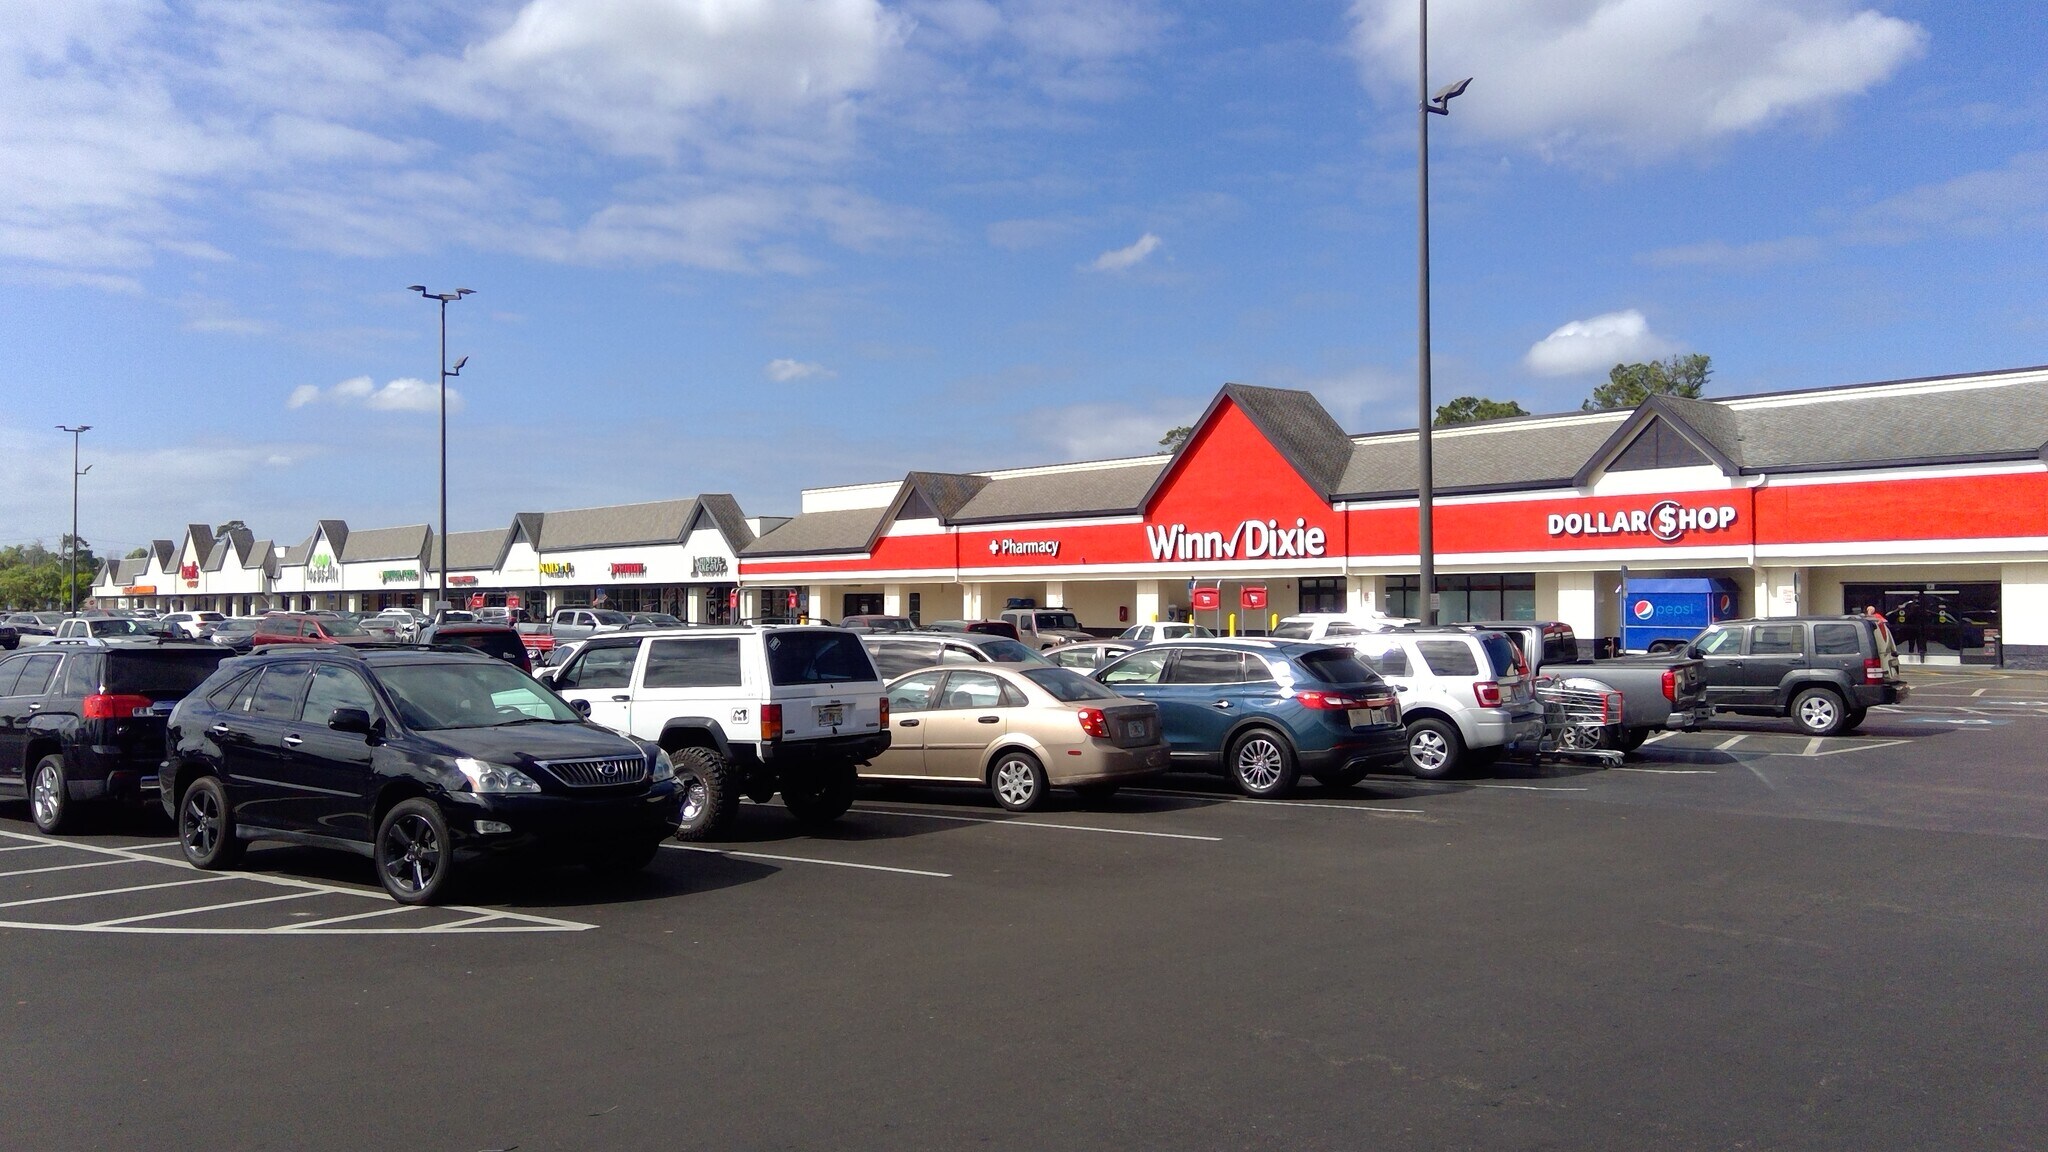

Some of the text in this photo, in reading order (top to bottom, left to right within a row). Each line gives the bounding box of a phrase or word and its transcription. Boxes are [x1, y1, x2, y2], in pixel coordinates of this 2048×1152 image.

[1548, 510, 1649, 535] DOLLAR
[1001, 539, 1060, 557] Pharmacy
[1146, 517, 1326, 560] Winn Dixie
[1656, 604, 1694, 616] pepsi
